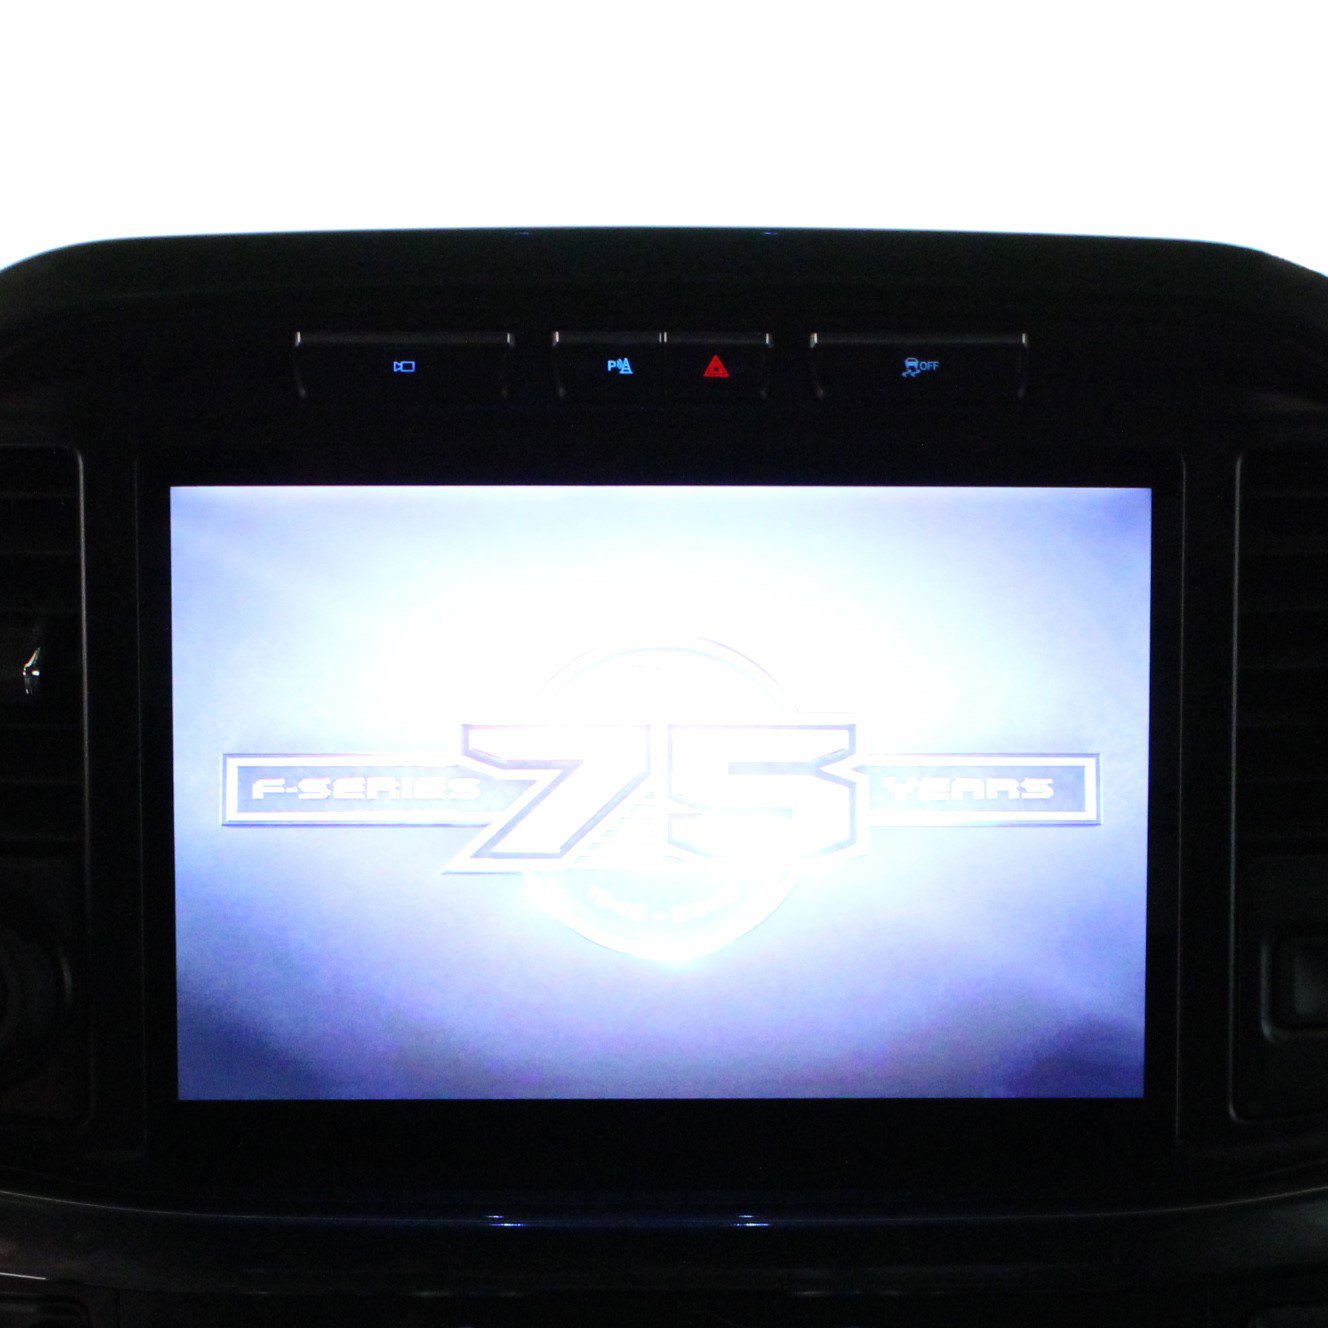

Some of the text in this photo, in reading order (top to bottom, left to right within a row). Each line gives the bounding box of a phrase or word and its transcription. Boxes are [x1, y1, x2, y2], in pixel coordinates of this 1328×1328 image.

[919, 360, 940, 372] OFF
[252, 722, 1054, 862] F-SERIES 75 YEARS
